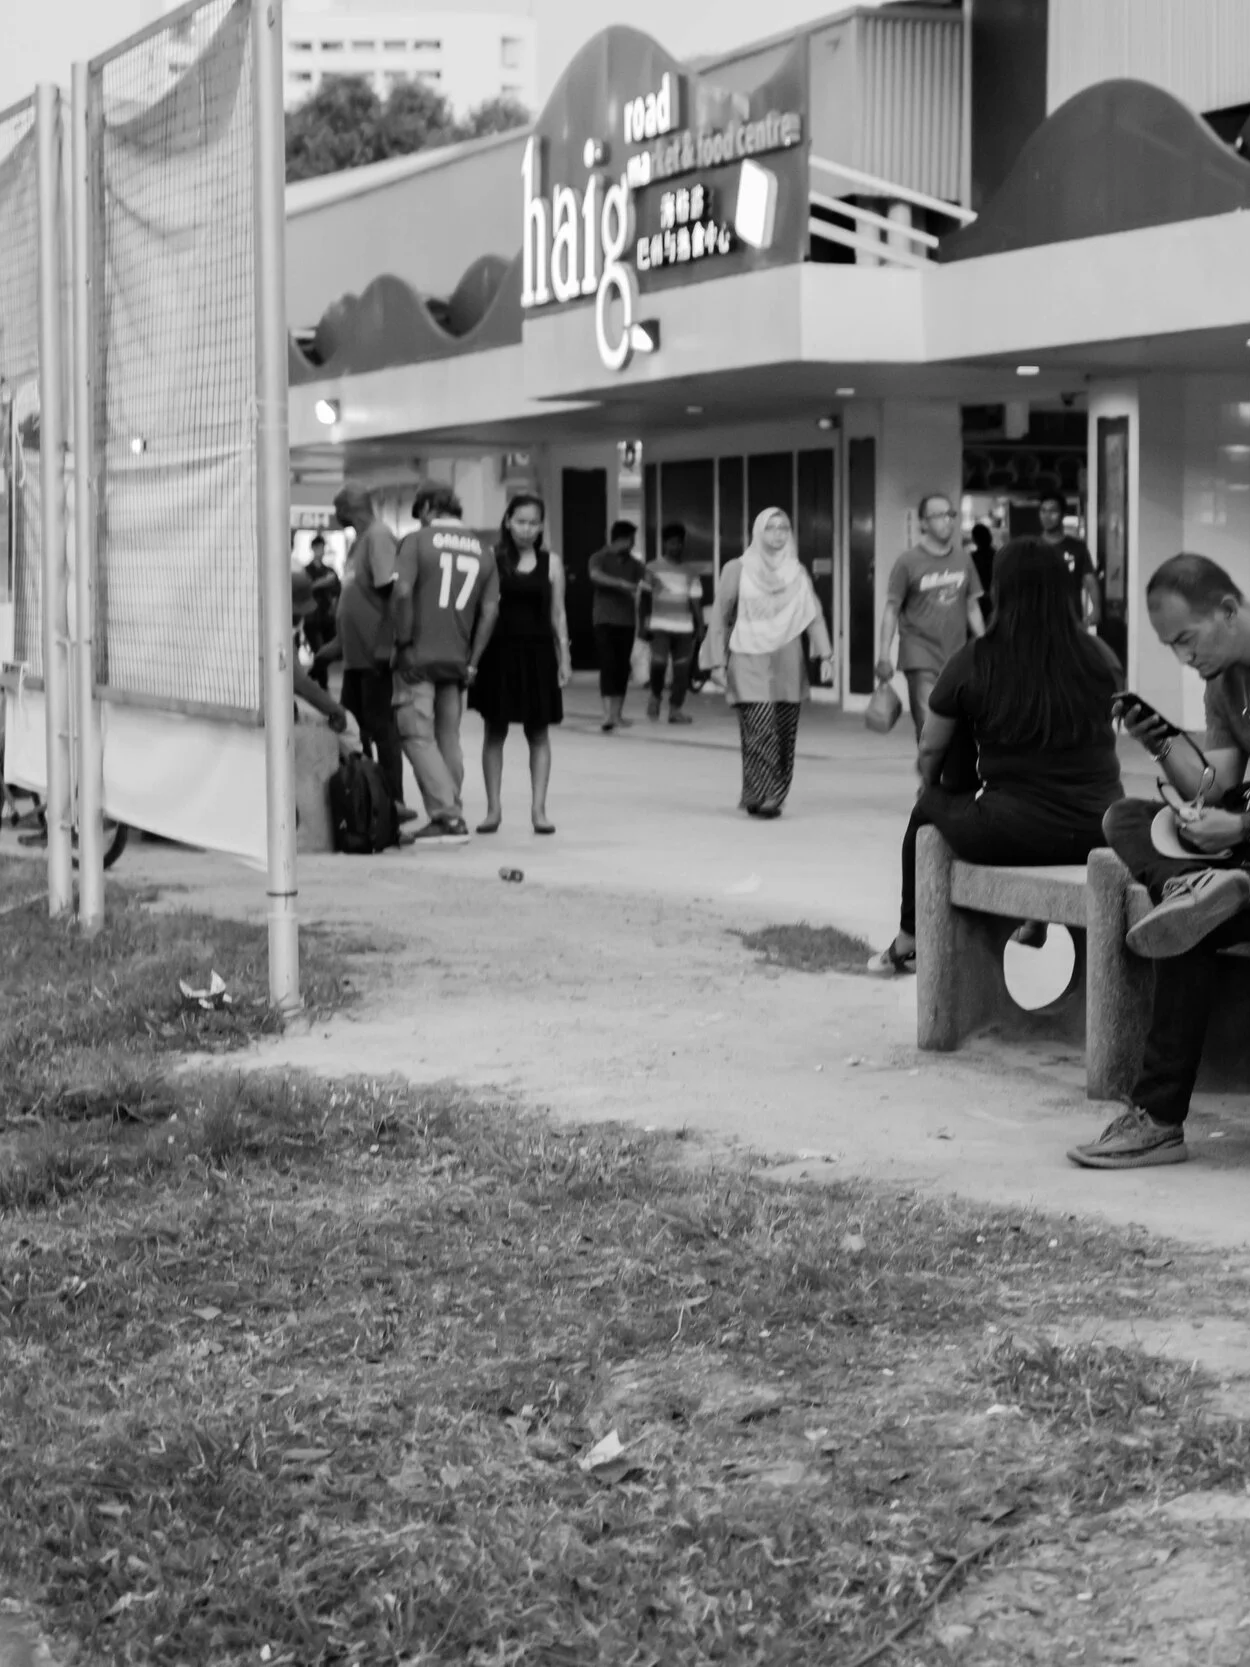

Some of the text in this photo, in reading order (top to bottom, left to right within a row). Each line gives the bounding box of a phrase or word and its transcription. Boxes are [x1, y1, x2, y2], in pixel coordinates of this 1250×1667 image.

[624, 71, 671, 144] road
[521, 135, 635, 370] haig
[439, 552, 480, 611] 17
